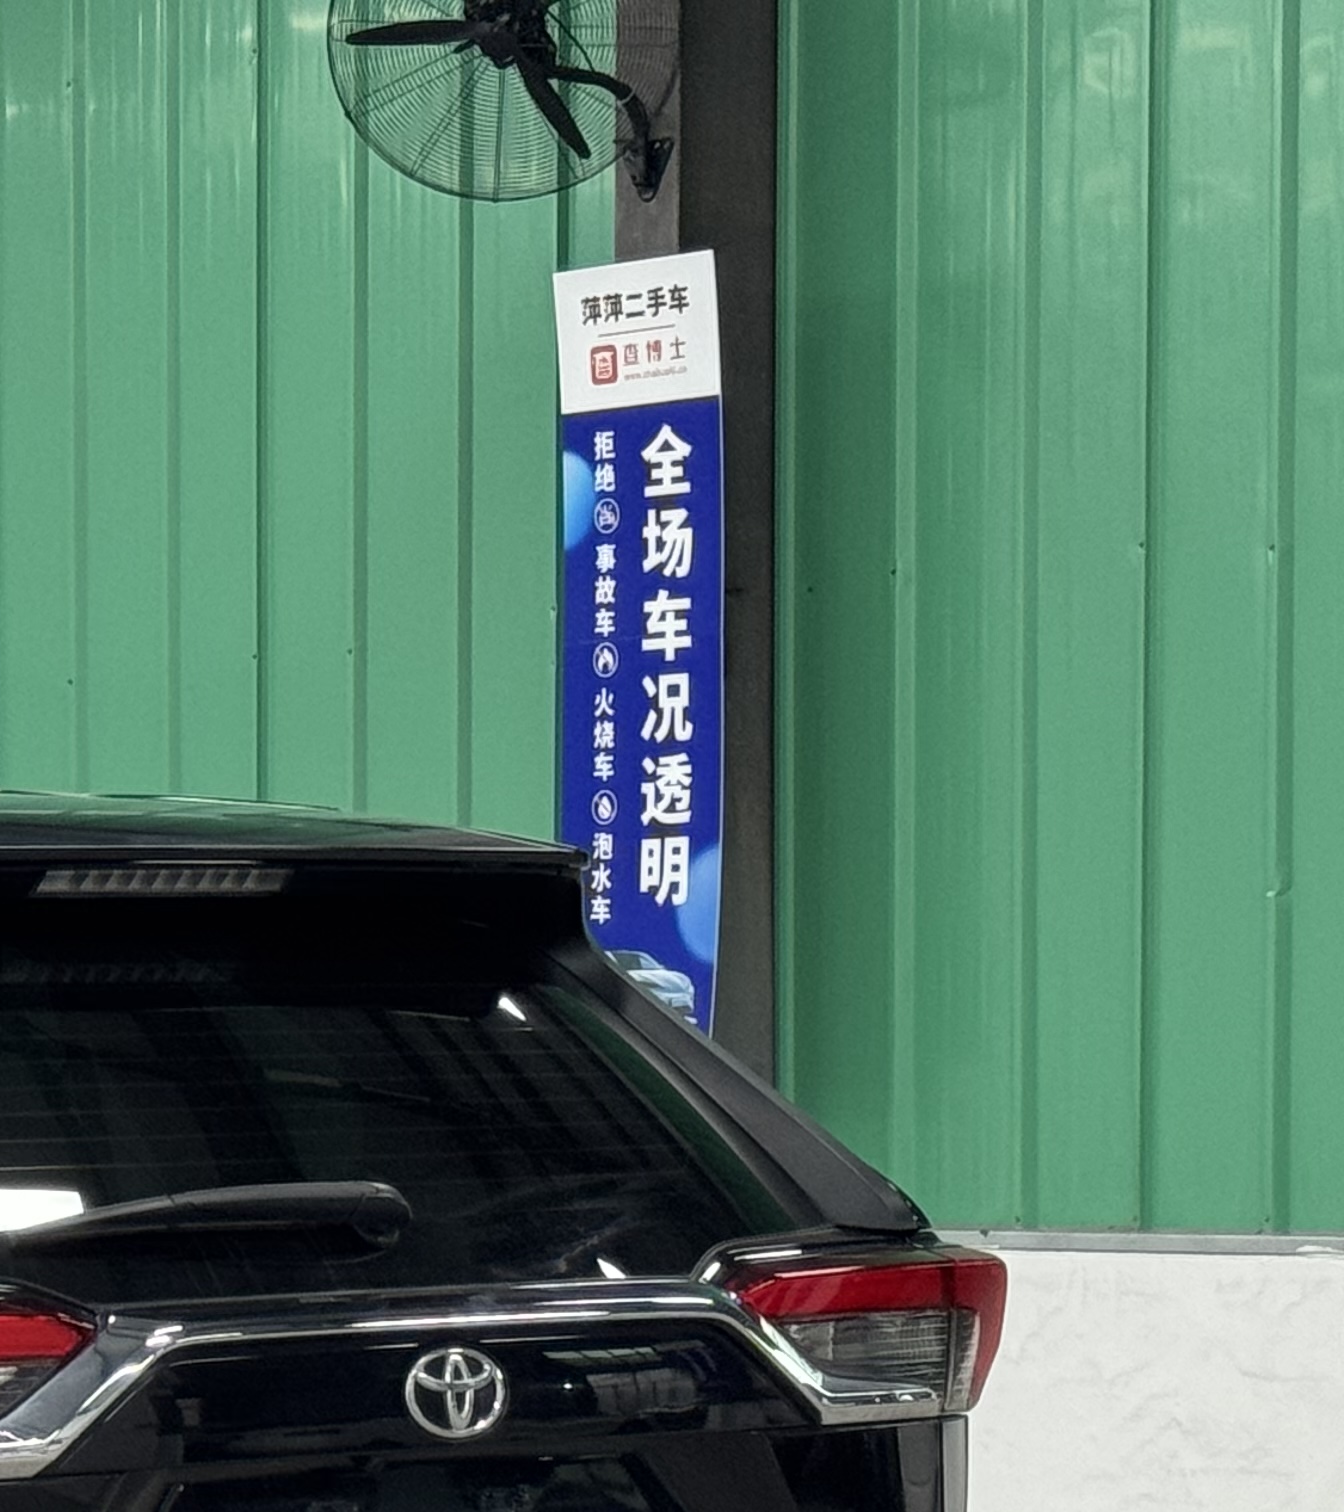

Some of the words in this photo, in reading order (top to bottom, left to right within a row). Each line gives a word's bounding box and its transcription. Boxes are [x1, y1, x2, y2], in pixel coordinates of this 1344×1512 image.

[580, 284, 691, 326] 萍萍二手车
[593, 431, 616, 492] 拒绝
[593, 545, 617, 637] 事故车
[639, 424, 694, 908] 全场车况透明
[592, 688, 616, 782] 火烧车
[590, 833, 613, 925] 泡水车
